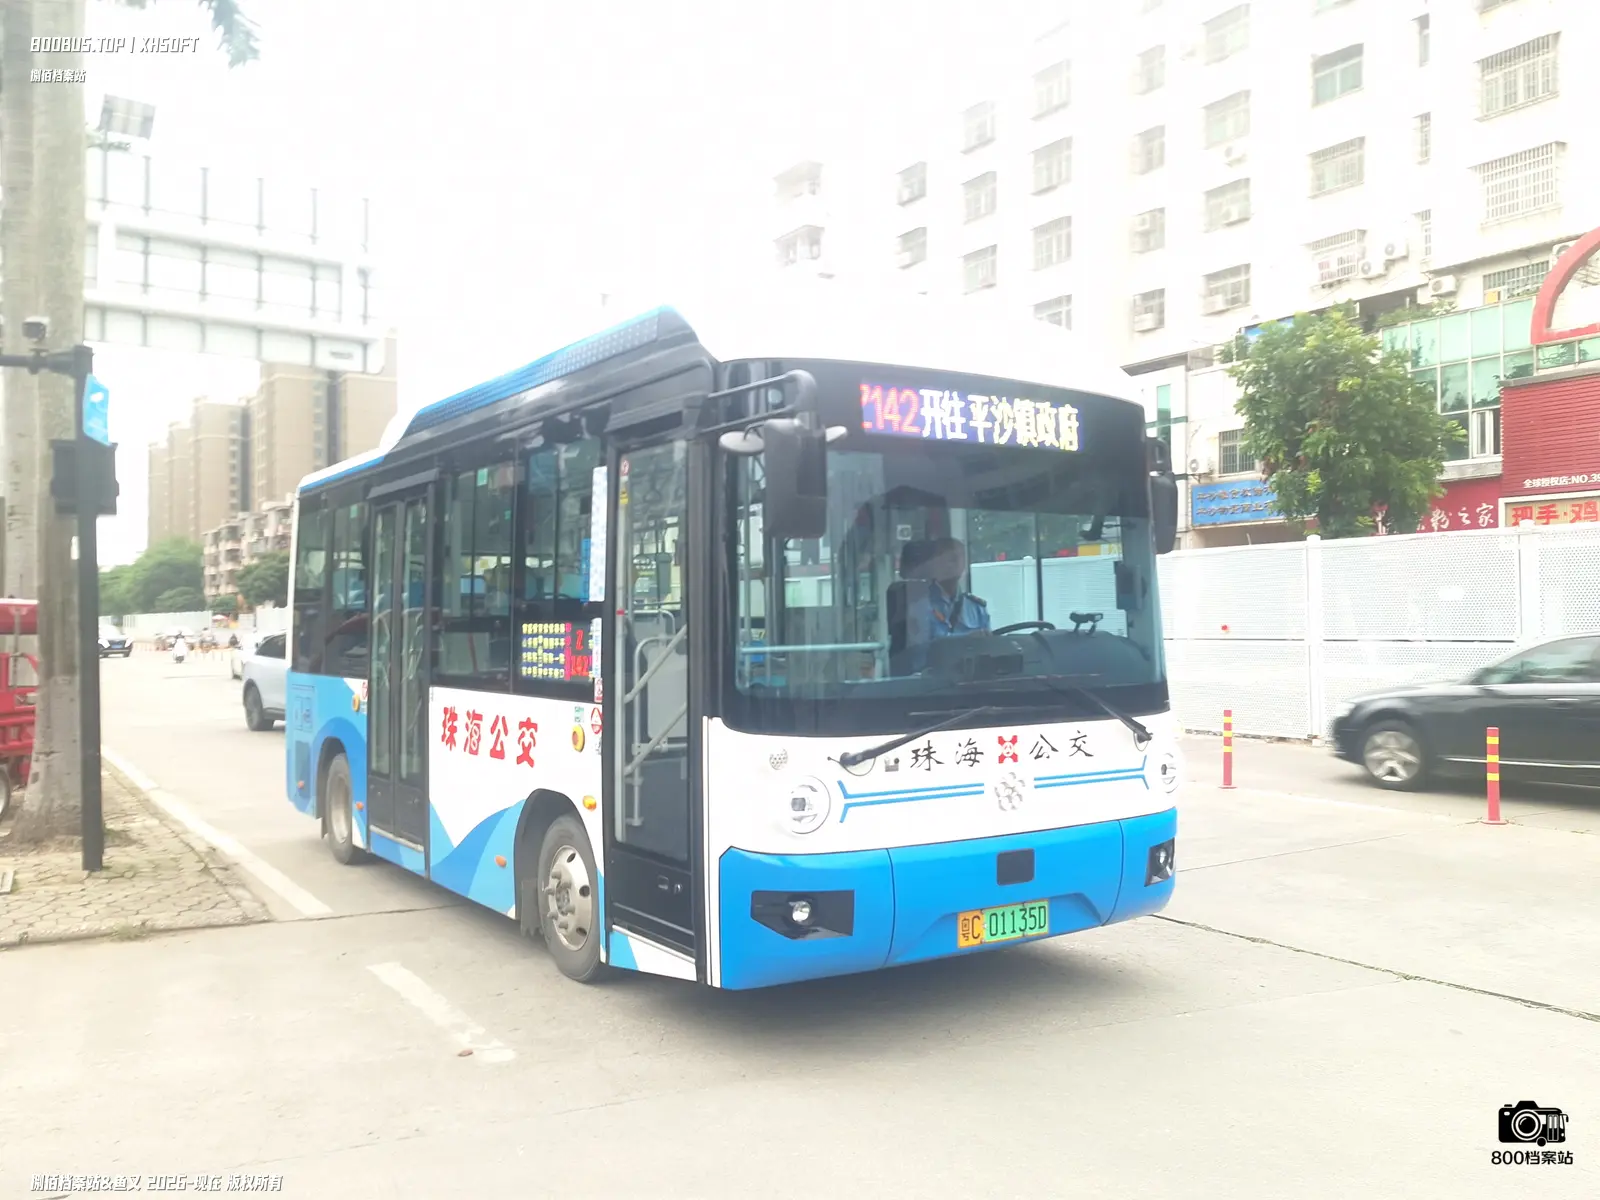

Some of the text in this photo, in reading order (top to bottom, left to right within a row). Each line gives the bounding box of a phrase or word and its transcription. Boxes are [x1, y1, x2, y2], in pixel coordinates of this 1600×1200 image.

[440, 705, 539, 769] 珠海公交
[910, 729, 1094, 772] 珠海 公交
[989, 905, 1047, 937] 01135D
